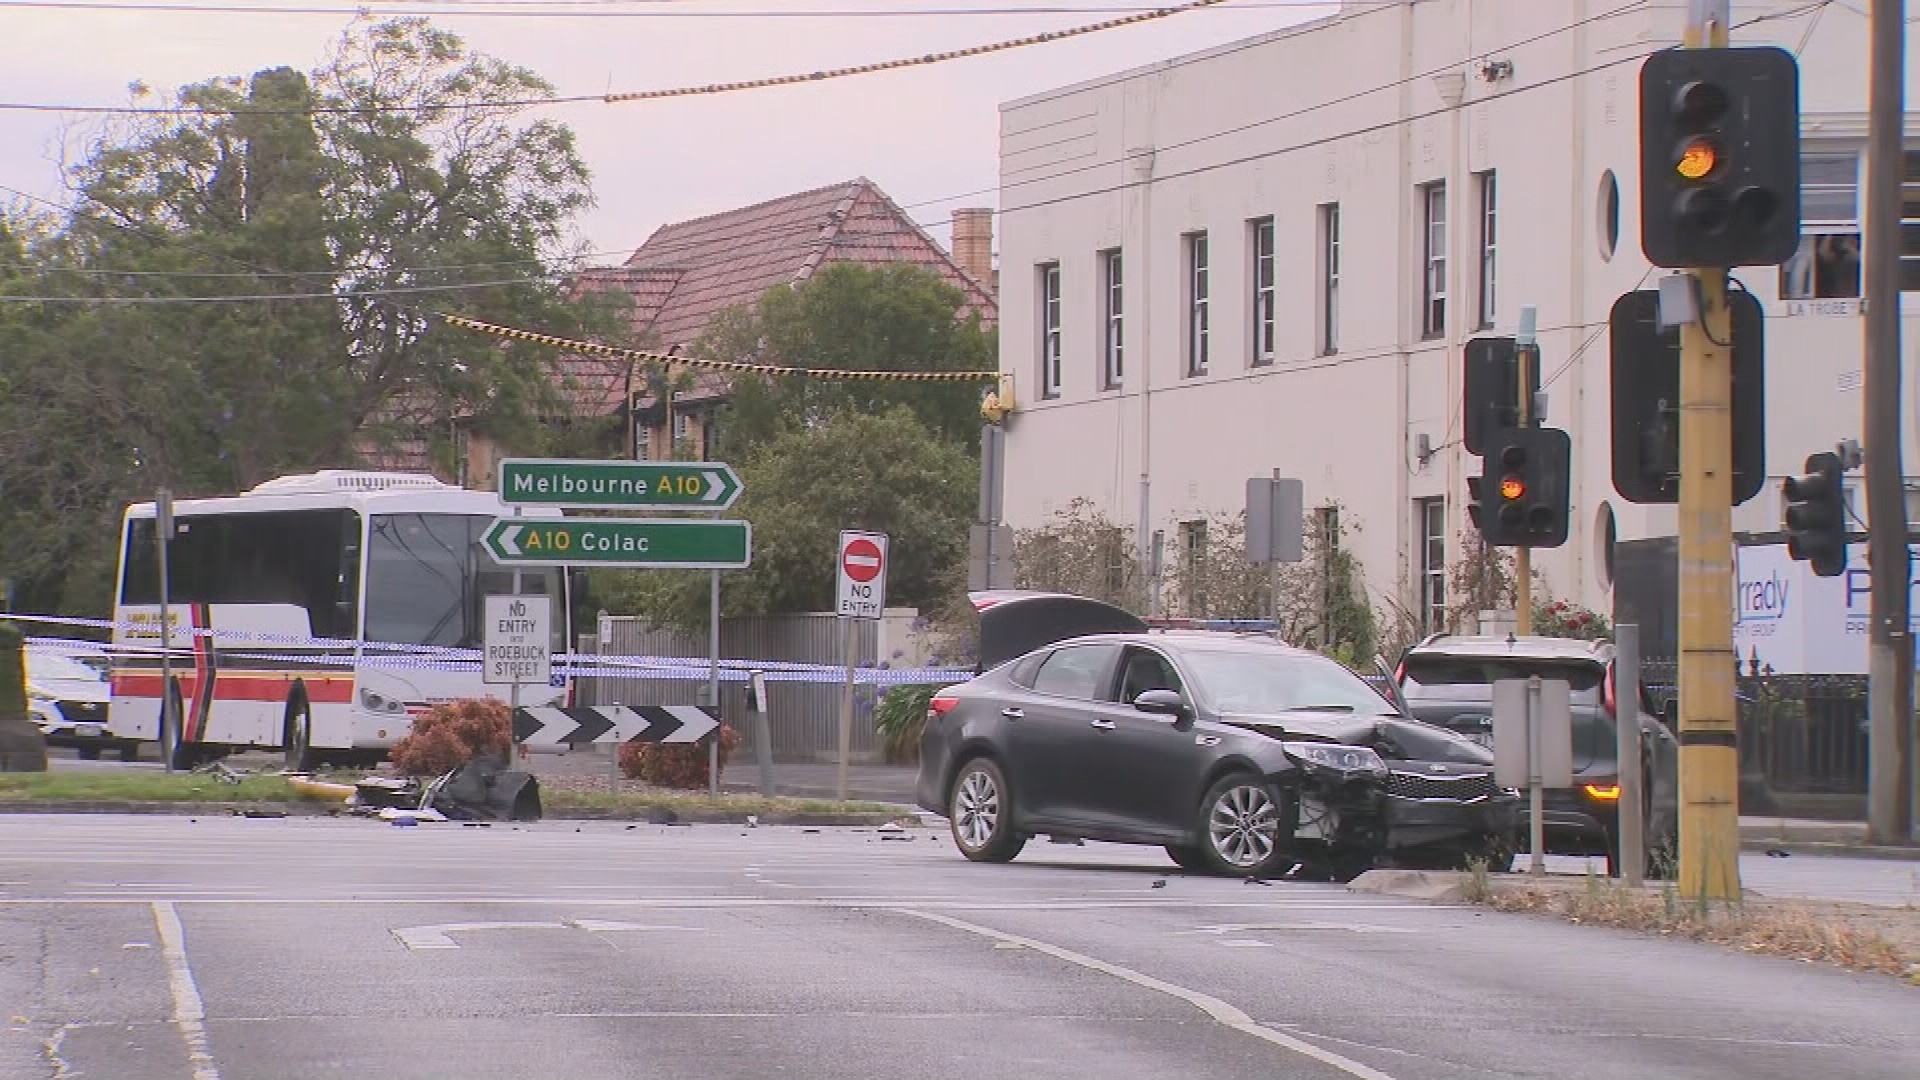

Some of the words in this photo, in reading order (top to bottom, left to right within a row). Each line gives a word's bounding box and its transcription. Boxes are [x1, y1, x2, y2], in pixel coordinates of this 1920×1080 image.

[513, 473, 648, 495] Melbourne
[656, 475, 701, 495] A10
[525, 529, 571, 551] A10
[580, 531, 649, 552] Colac
[850, 584, 873, 599] NO
[508, 602, 527, 617] NO
[842, 599, 878, 613] ENTRY
[498, 619, 537, 633] ENTRY
[489, 645, 546, 661] ROEBUCK
[495, 661, 540, 677] STREET
